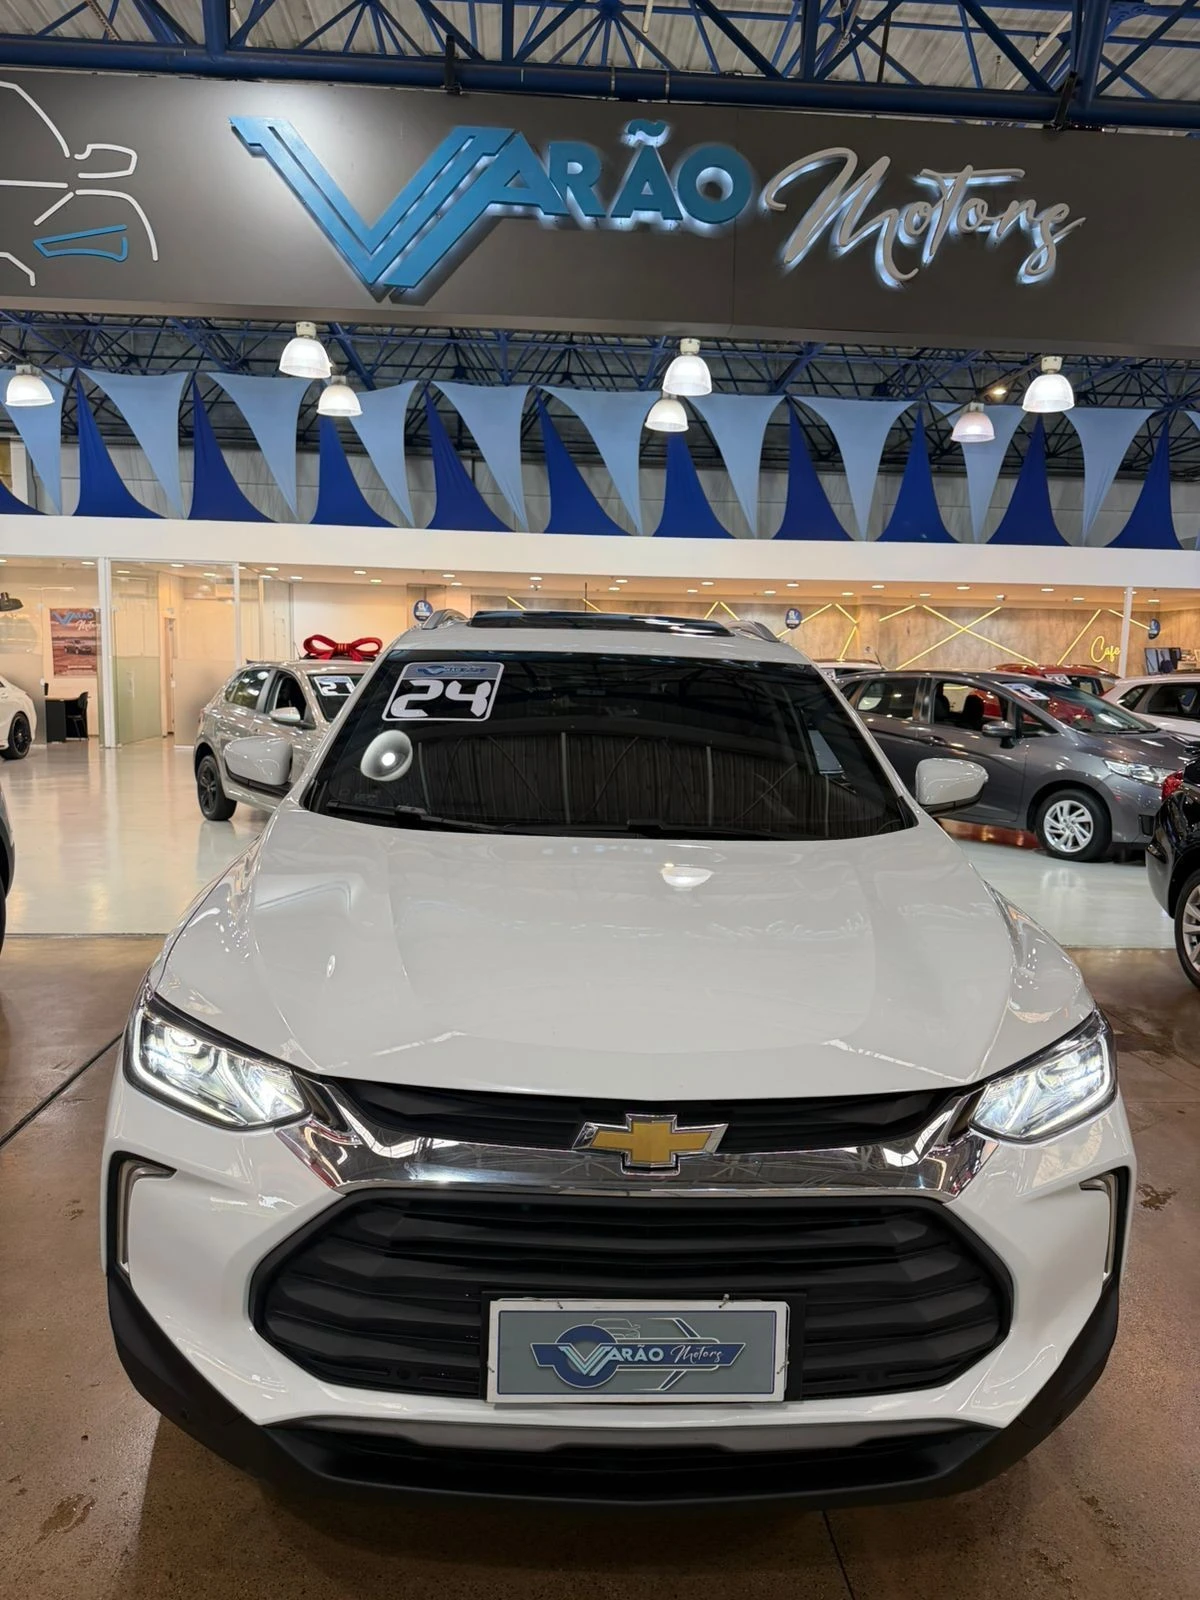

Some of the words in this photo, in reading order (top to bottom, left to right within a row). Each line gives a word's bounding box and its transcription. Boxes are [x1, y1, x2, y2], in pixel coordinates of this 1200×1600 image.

[229, 117, 753, 290] VARÃO
[763, 147, 1087, 284] Motors
[390, 680, 492, 717] 24
[558, 1344, 664, 1376] VARÃO
[671, 1344, 724, 1364] Motors
